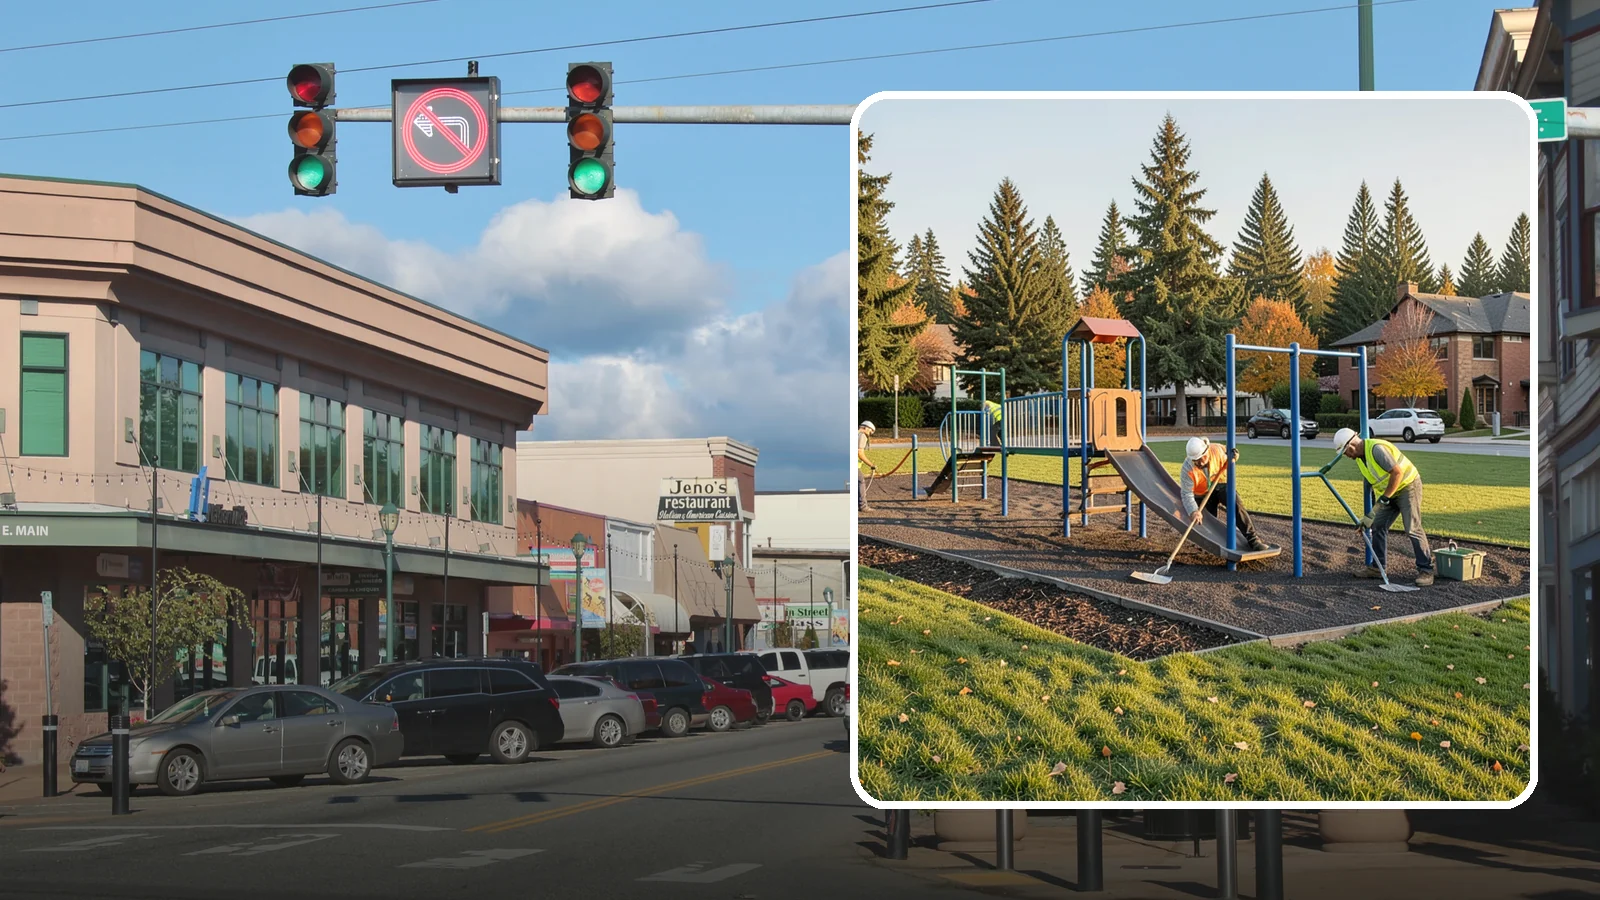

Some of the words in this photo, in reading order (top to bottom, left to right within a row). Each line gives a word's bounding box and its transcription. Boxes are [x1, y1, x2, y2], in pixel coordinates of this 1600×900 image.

[669, 480, 728, 494] Jeno's
[665, 496, 731, 509] restaurant
[659, 510, 682, 520] Italian
[686, 510, 714, 519] American
[715, 509, 737, 519] Cuisine
[2, 525, 13, 536] E.
[15, 525, 49, 536] MAIN
[797, 608, 829, 616] Street
